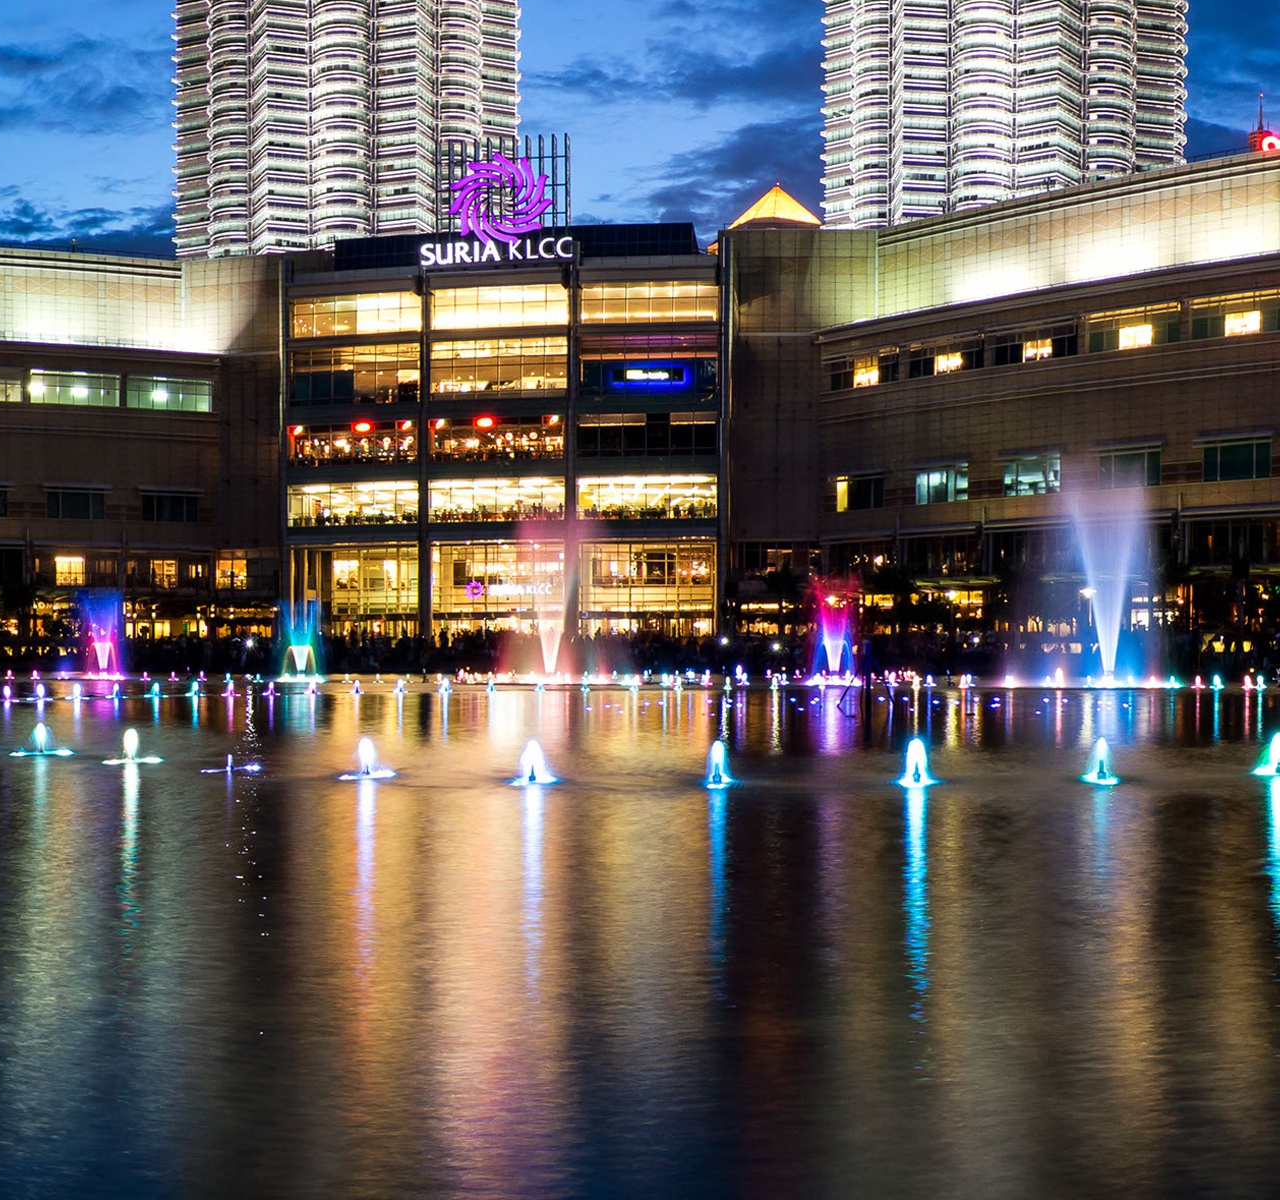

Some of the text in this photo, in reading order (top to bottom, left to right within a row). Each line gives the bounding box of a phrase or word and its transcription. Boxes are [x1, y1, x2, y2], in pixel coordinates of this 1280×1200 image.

[420, 236, 573, 266] SURIA KLCC
[525, 583, 553, 595] KLCC
